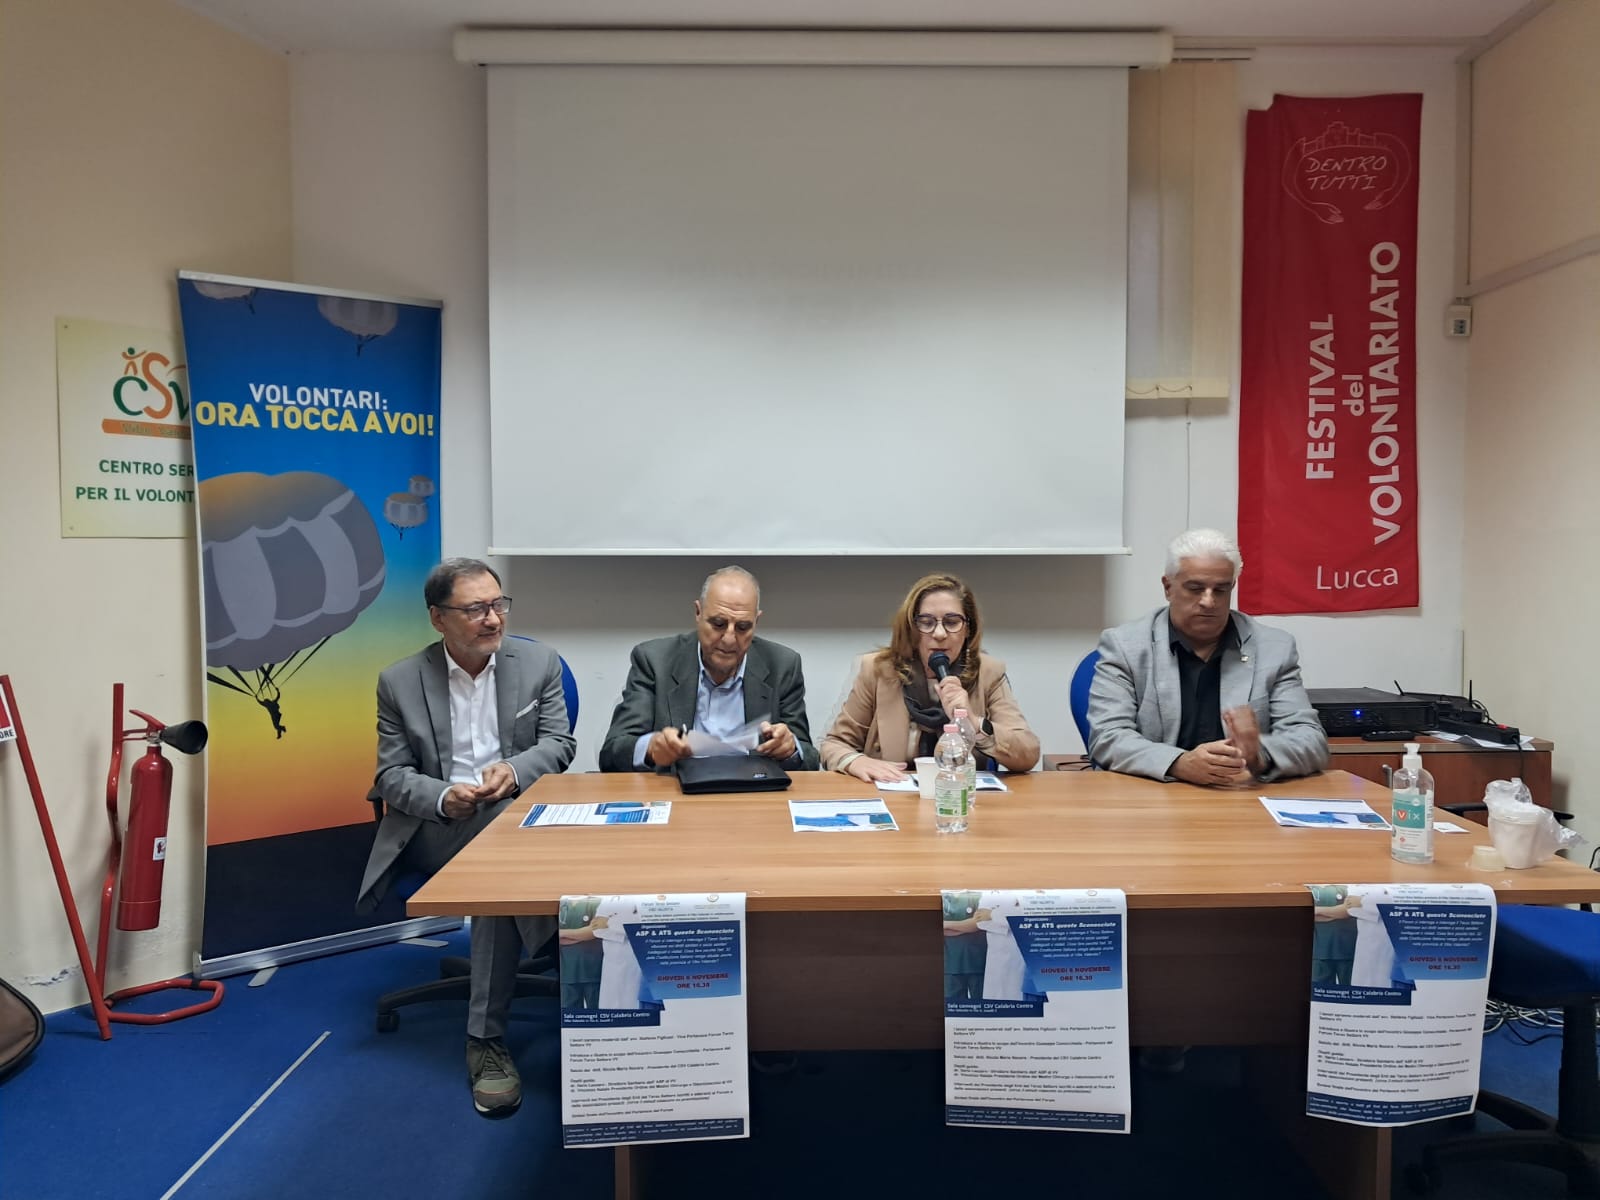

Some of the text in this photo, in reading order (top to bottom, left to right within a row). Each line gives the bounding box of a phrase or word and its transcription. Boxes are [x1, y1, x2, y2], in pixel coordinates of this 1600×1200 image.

[1305, 156, 1387, 172] DENTRO
[1307, 174, 1377, 190] TUTTI
[248, 383, 388, 410] VOLONTARI:
[1305, 313, 1335, 480] FESTIVAL
[1341, 374, 1365, 418] del
[1368, 241, 1402, 545] VOLONTARIATO
[195, 401, 434, 437] ORA TOCCA A VOI!
[99, 460, 163, 476] CENTRO
[76, 487, 107, 501] PER
[114, 488, 131, 501] IL
[1315, 565, 1398, 591] Lucca
